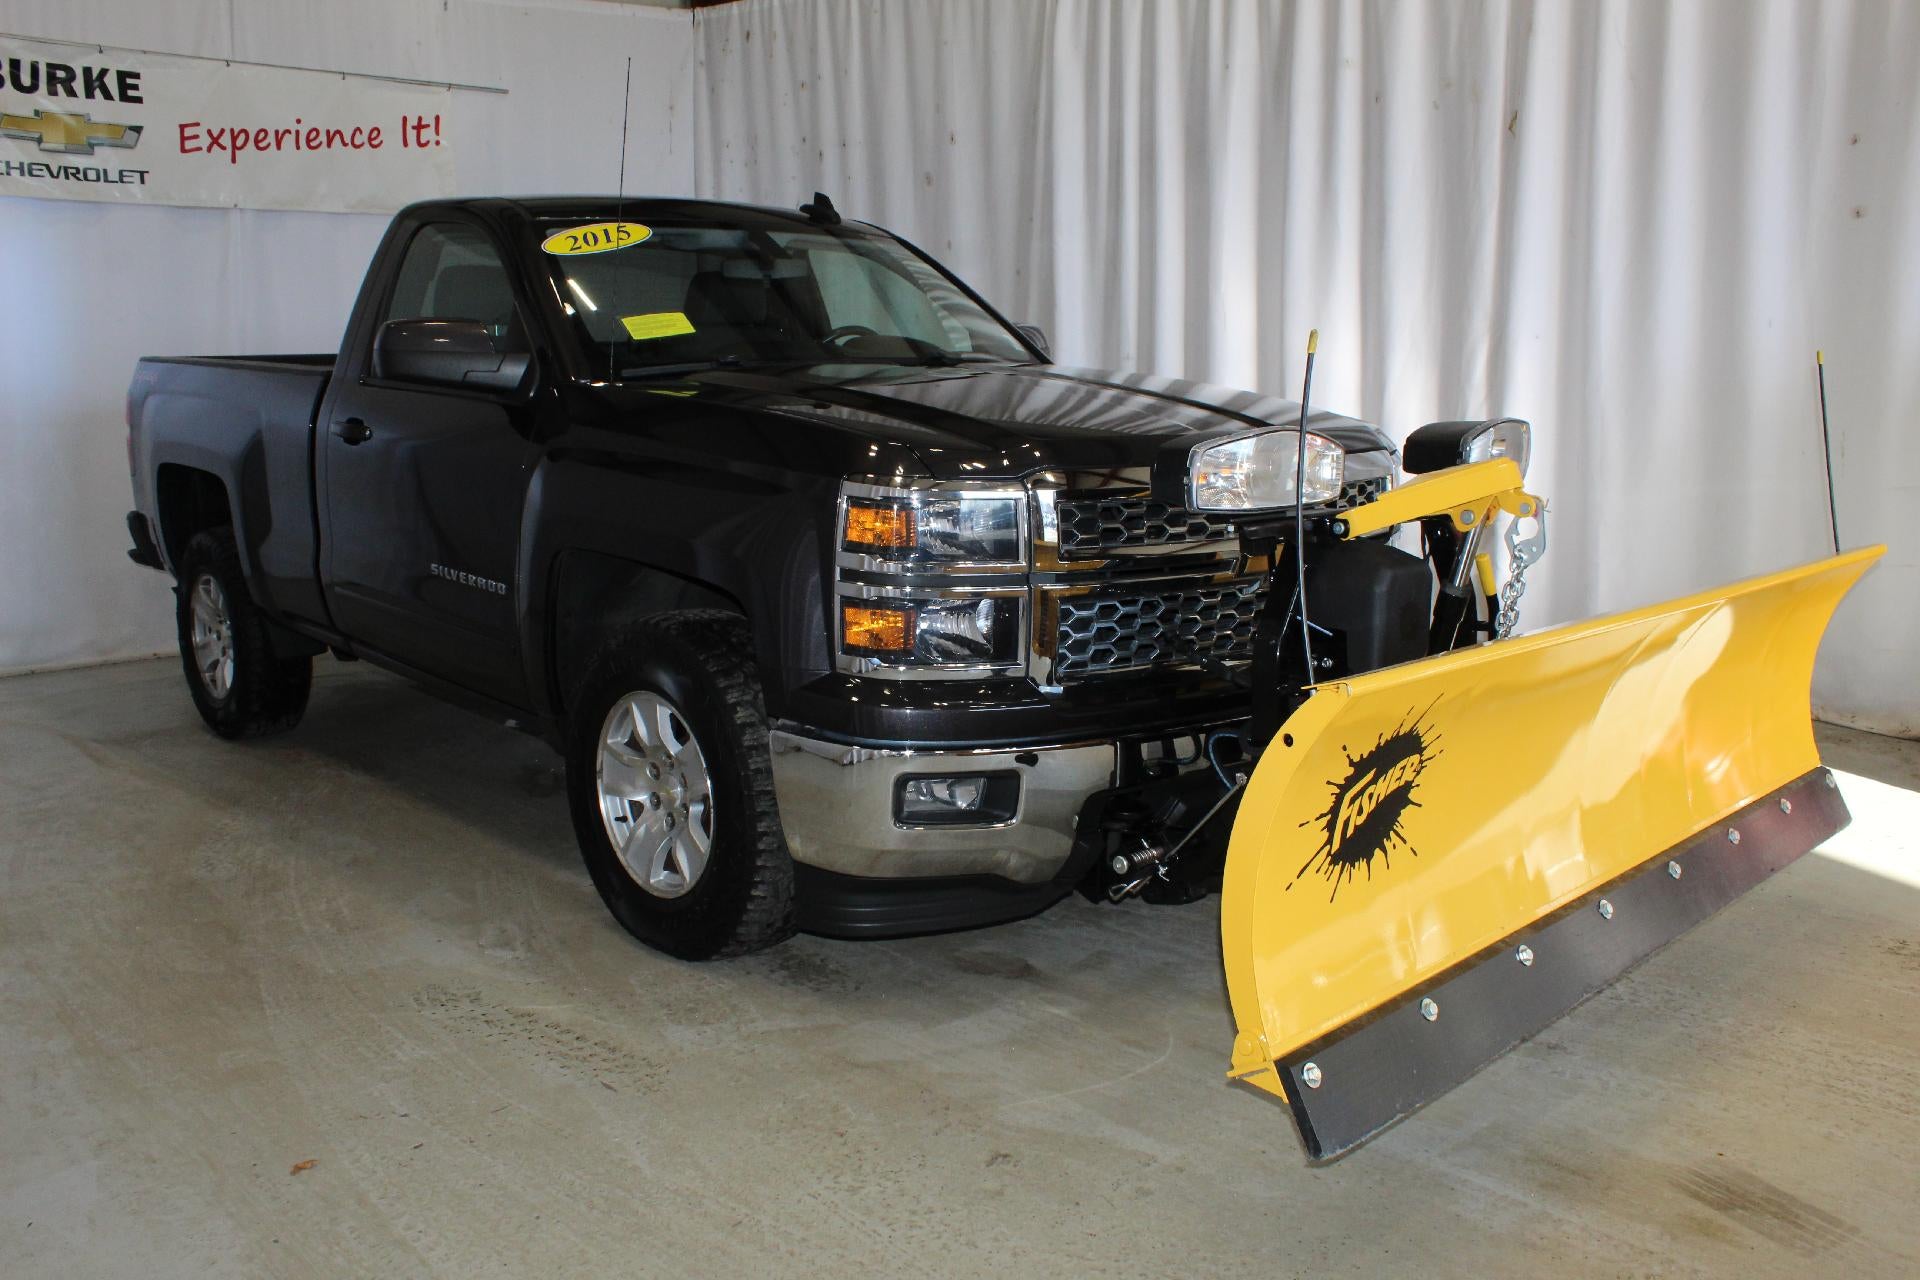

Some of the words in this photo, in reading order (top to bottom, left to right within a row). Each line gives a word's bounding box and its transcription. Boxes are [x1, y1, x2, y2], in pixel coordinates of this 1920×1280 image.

[0, 57, 144, 105] URKE
[178, 119, 384, 163] Experience
[401, 114, 442, 148] It!
[0, 160, 150, 185] HEVROLET
[566, 225, 631, 252] 2015
[430, 562, 507, 596] SILVERADO
[1331, 753, 1423, 855] FISHER
